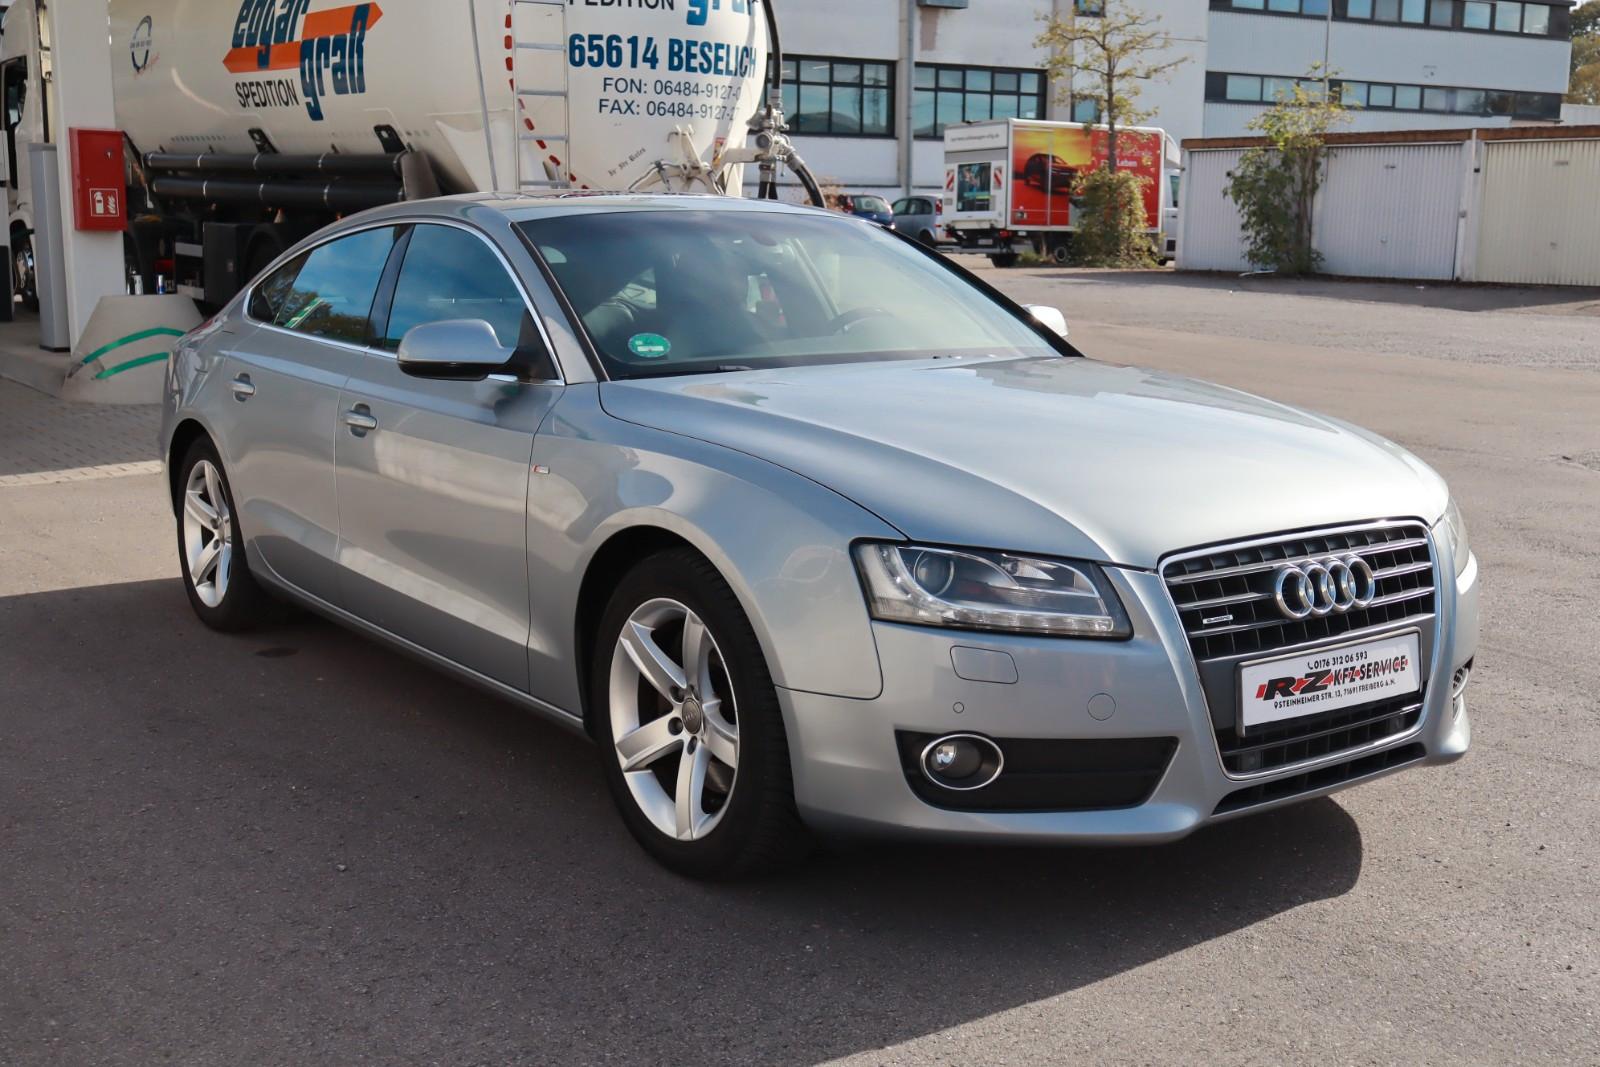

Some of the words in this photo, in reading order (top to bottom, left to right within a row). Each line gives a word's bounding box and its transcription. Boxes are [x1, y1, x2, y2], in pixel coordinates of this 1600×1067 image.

[569, 33, 659, 70] 65614
[668, 38, 757, 79] BESELICH
[235, 79, 299, 108] SPEDITION
[603, 77, 648, 94] FON:
[599, 98, 641, 115] FAX:
[1314, 659, 1330, 669] 0176
[1332, 656, 1344, 666] 312
[1345, 653, 1354, 663] 06
[1356, 650, 1368, 660] 593
[1279, 694, 1320, 709] STEINHEIMER
